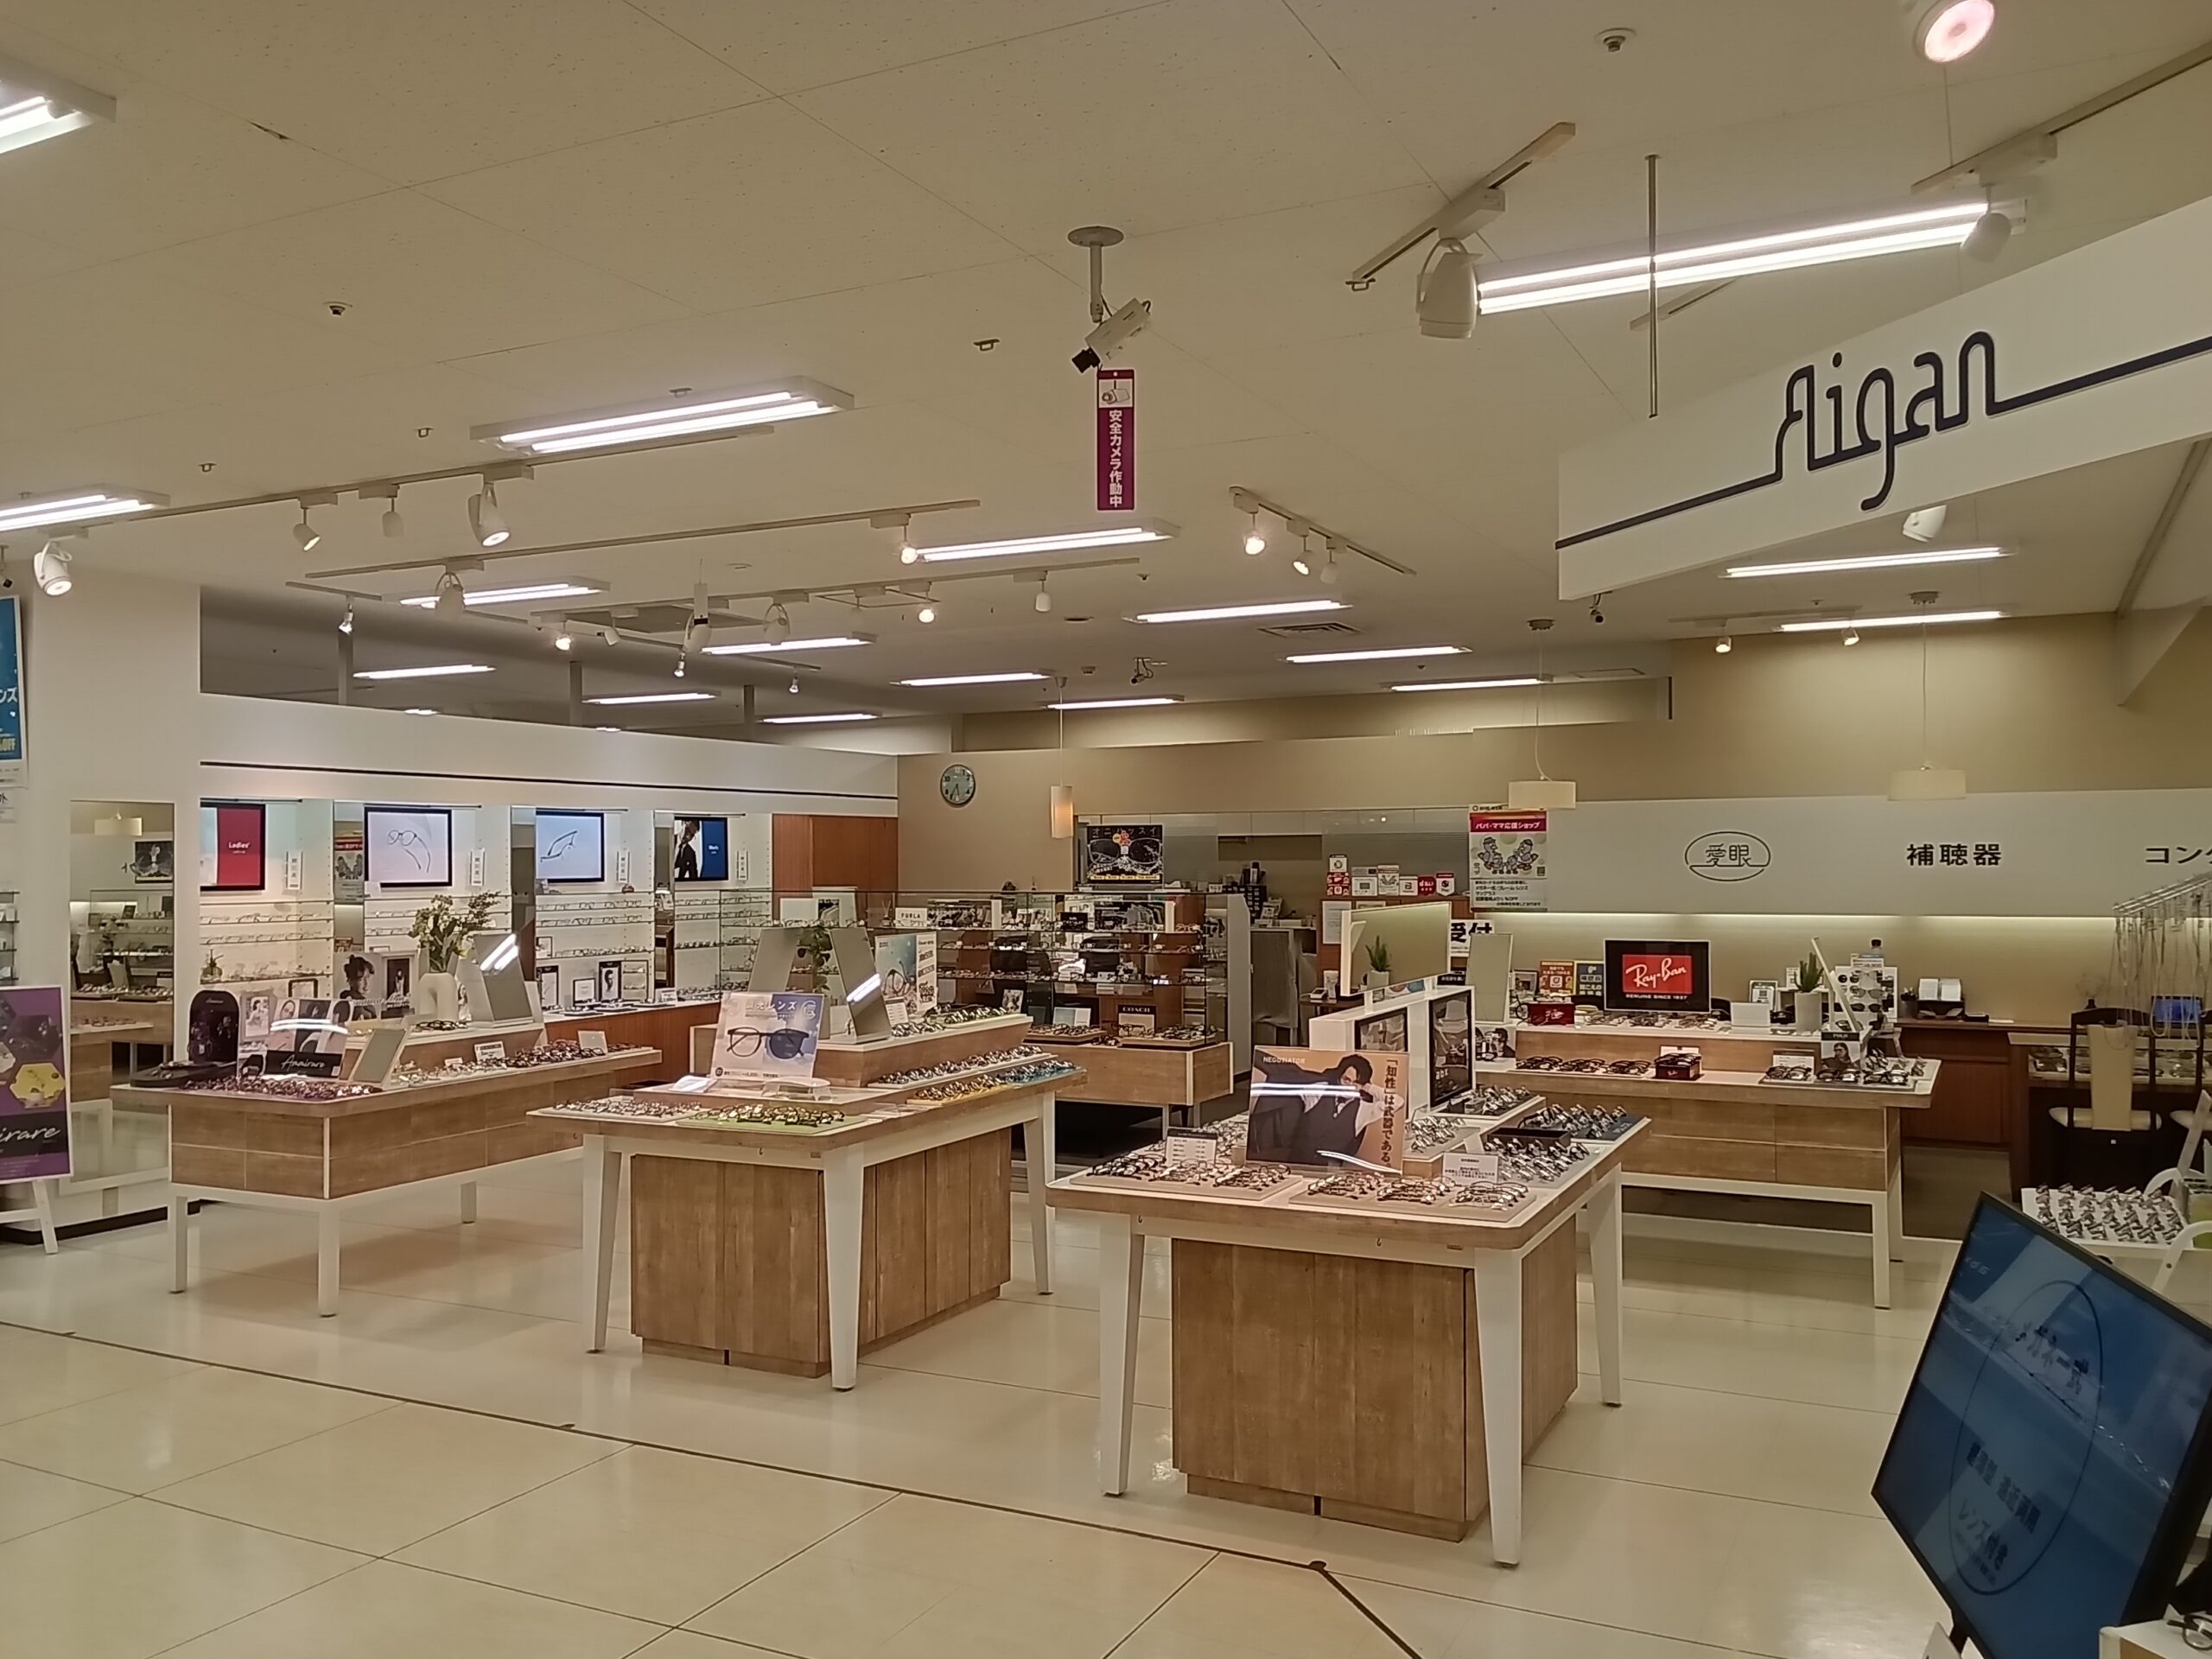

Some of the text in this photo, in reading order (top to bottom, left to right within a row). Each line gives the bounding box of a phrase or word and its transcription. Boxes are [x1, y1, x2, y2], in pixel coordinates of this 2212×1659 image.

[1775, 330, 1996, 511] Aigan
[1109, 410, 1122, 508] 安全カメラ作動中
[1706, 843, 1751, 867] 愛眼
[1906, 843, 2002, 866] 補聴器
[1625, 957, 1687, 988] Ray-Ban
